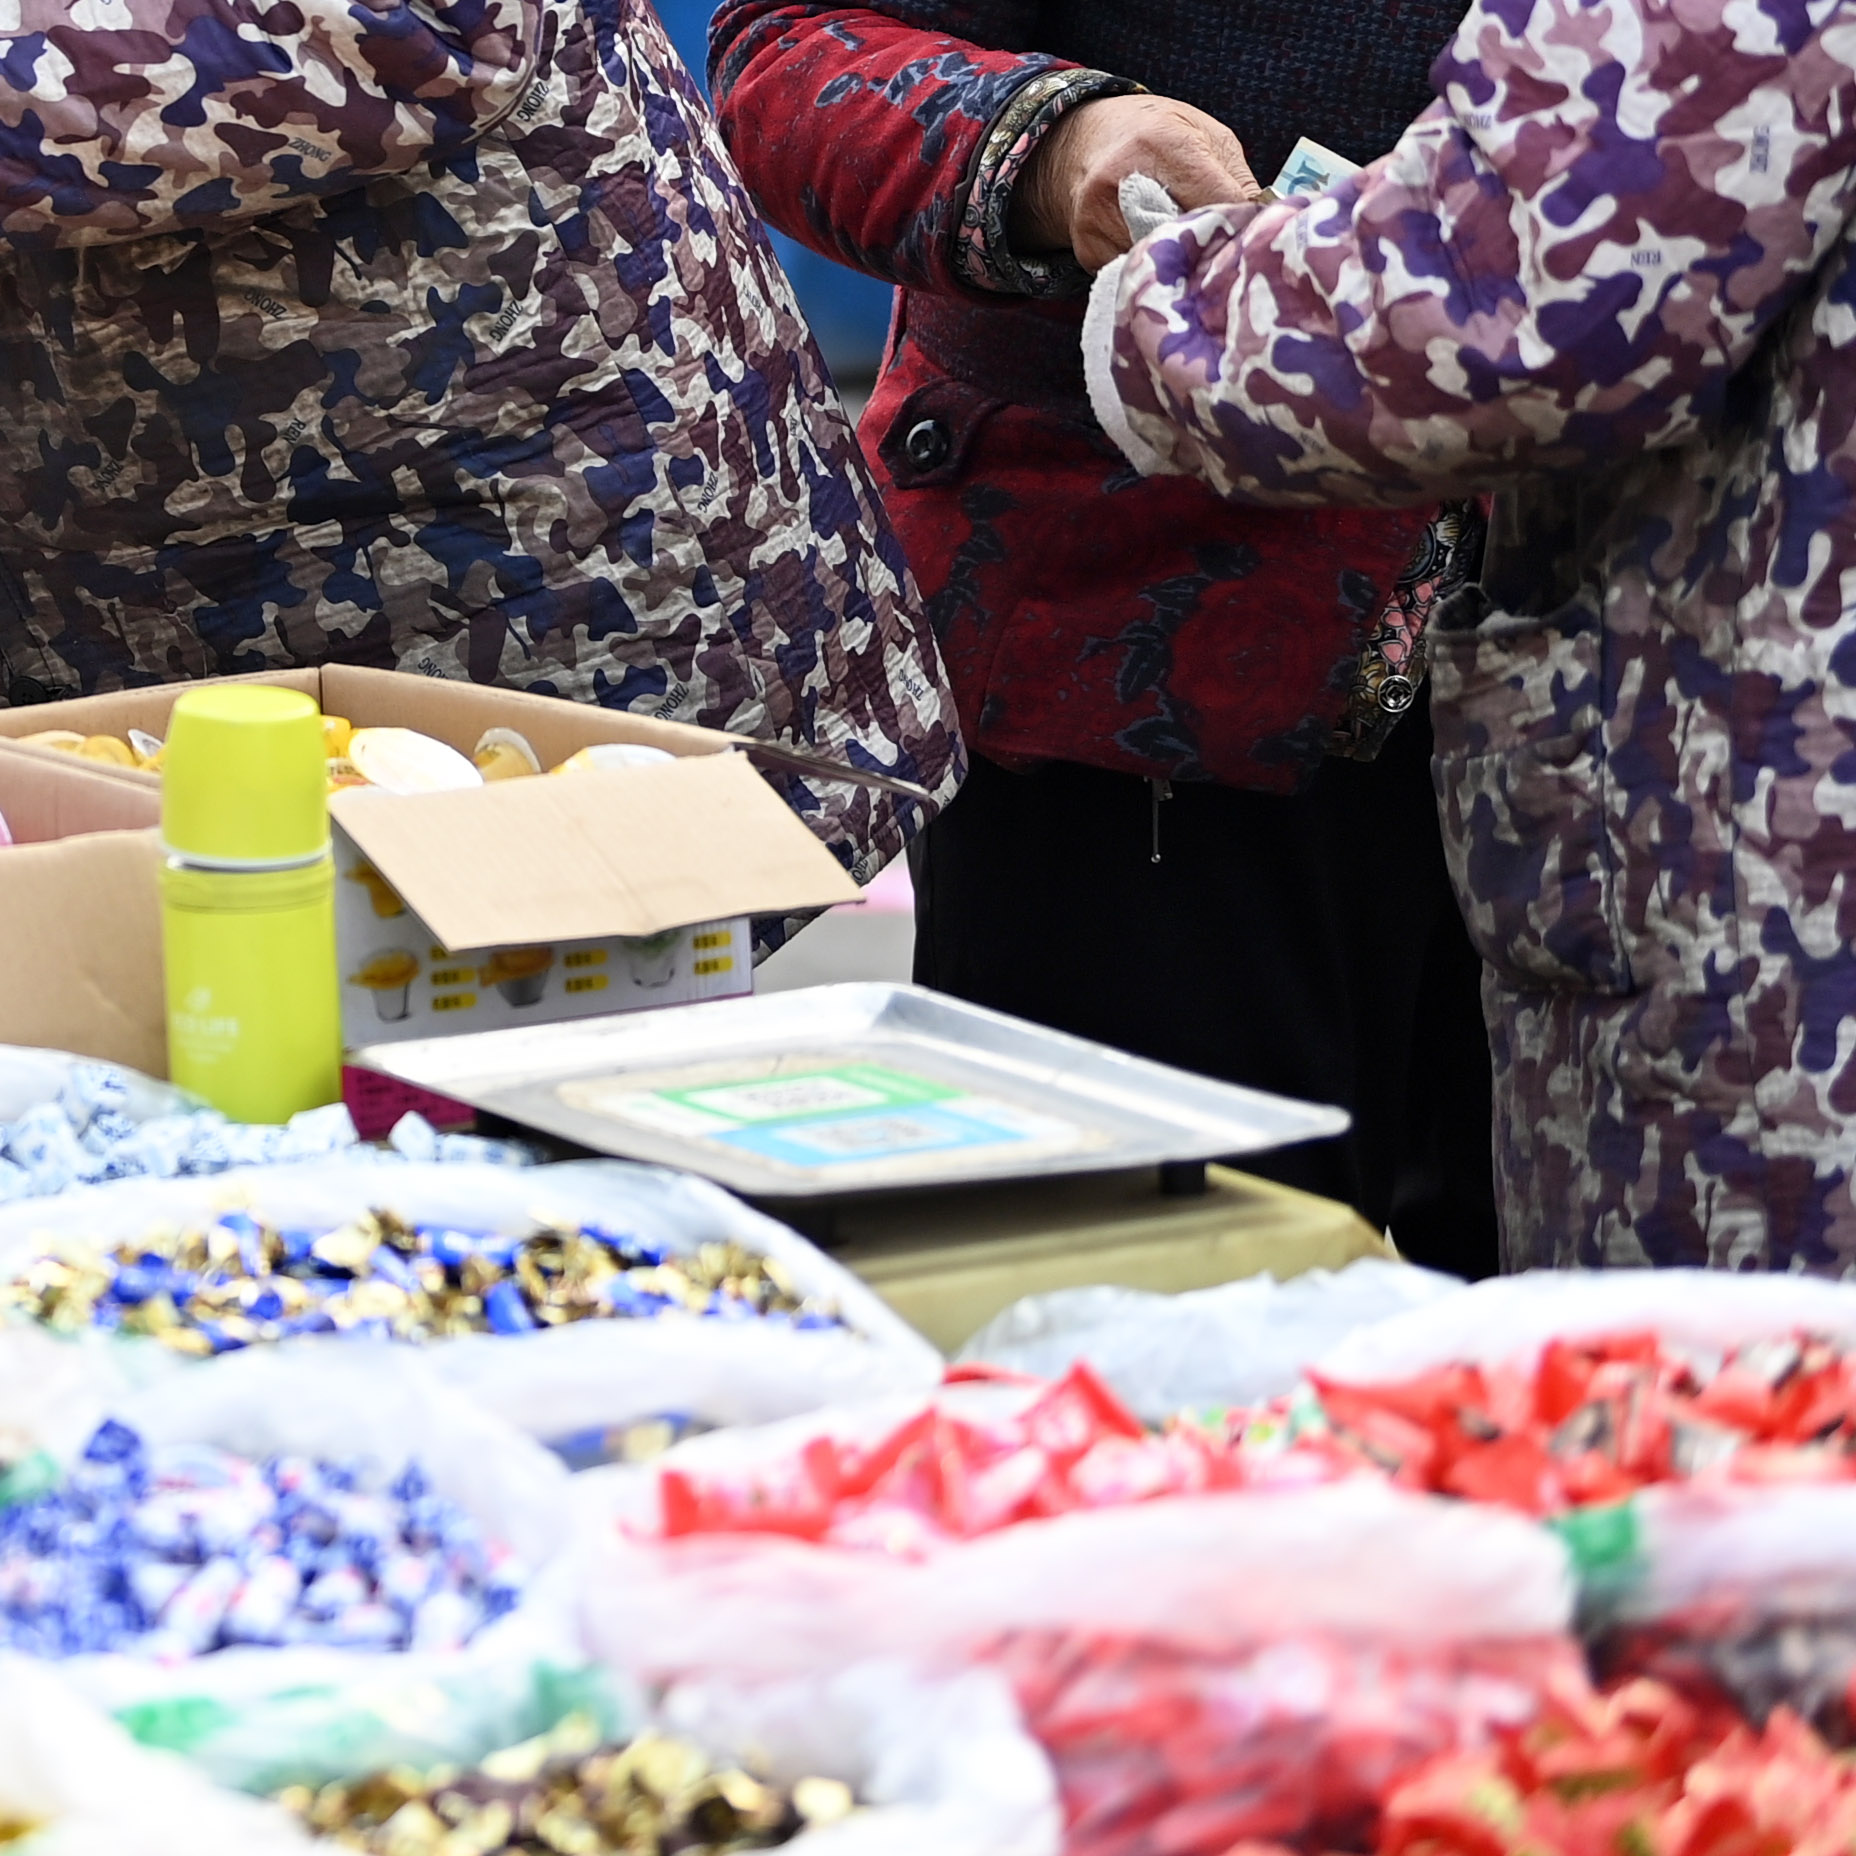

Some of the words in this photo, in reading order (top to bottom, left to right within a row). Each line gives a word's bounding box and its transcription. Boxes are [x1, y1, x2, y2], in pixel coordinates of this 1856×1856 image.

[517, 81, 550, 122] ZHONG
[289, 137, 332, 163] ZHONG
[244, 287, 287, 320] ZHONG
[490, 300, 523, 343] ZHONG
[284, 417, 306, 444] REN
[697, 471, 718, 514] ZHONG
